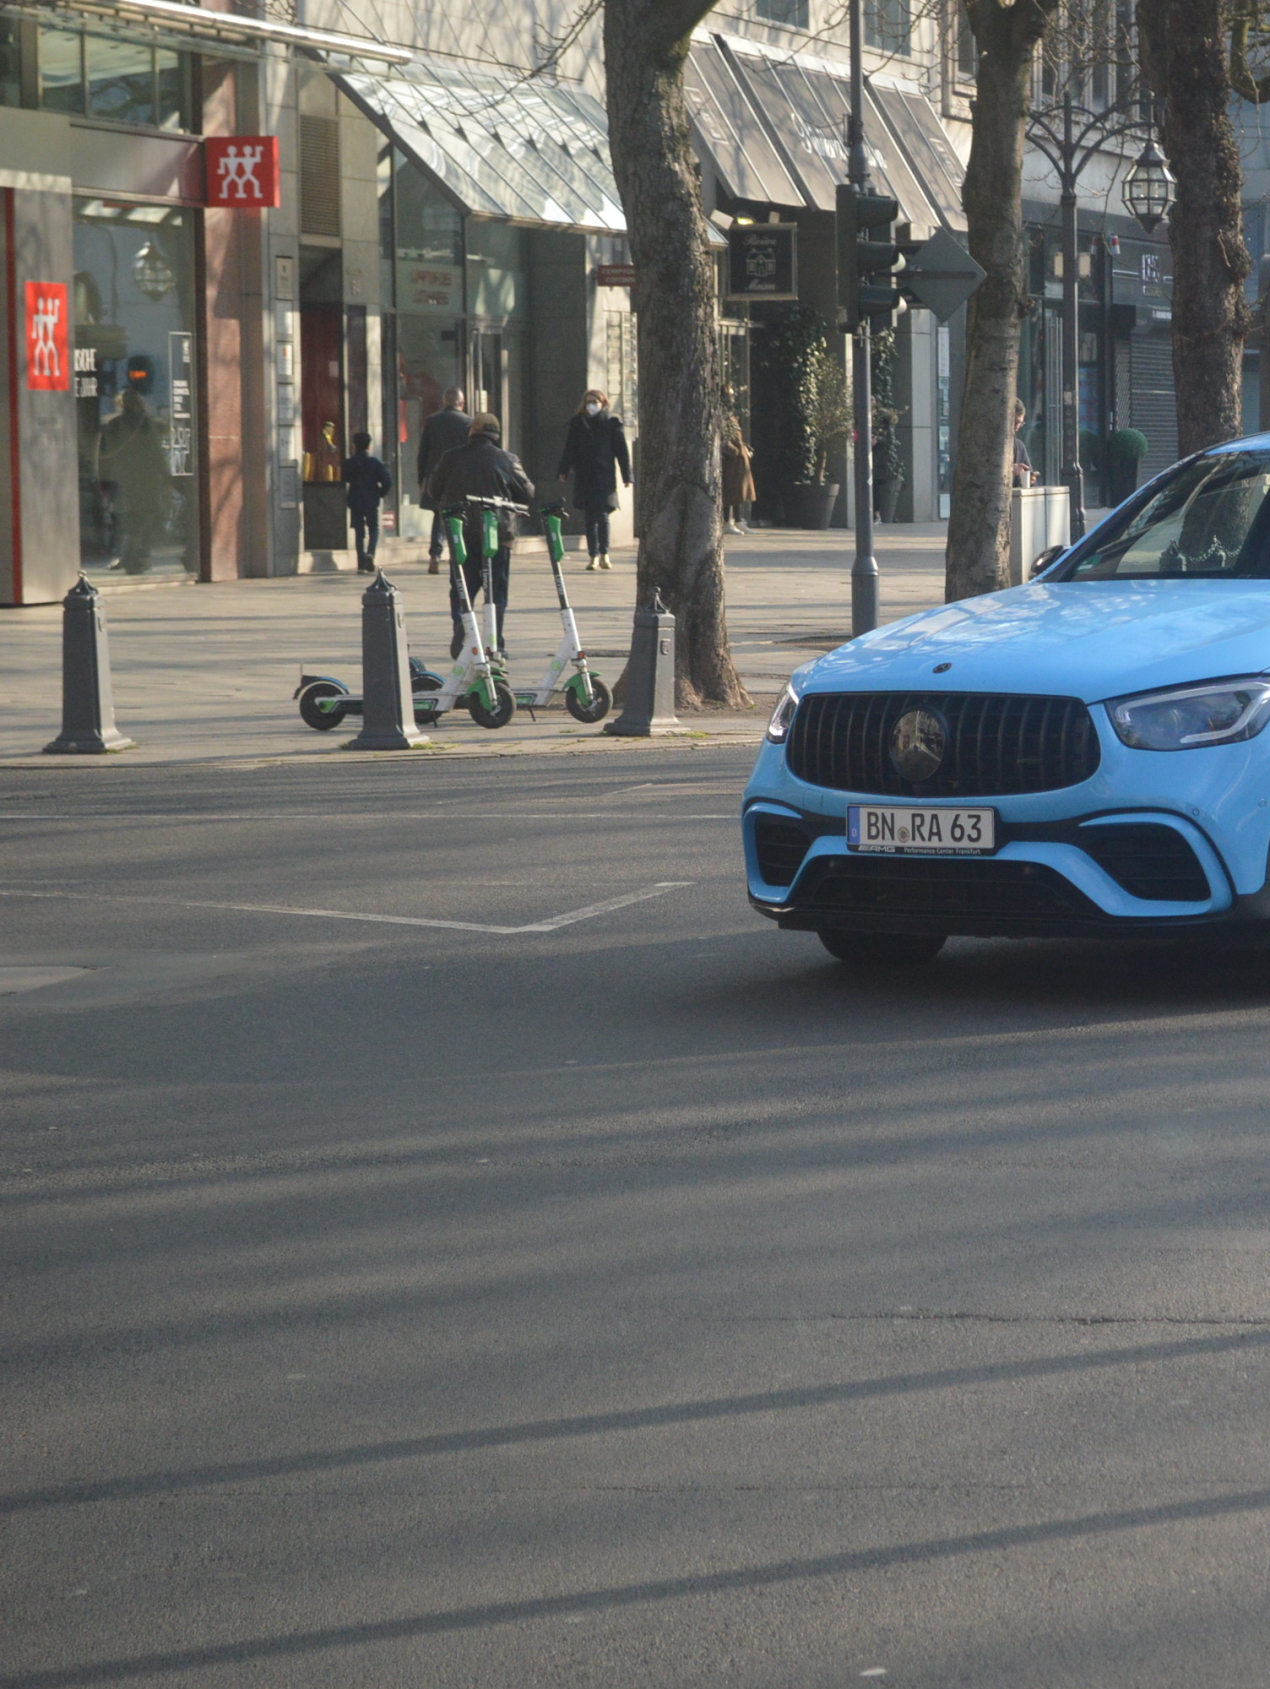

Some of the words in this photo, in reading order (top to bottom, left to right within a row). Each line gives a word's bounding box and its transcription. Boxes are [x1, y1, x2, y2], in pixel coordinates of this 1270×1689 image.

[867, 812, 895, 841] BN
[911, 813, 943, 843] RA
[951, 813, 982, 843] 63
[903, 847, 936, 855] Performance
[955, 848, 981, 856] Frankfurt
